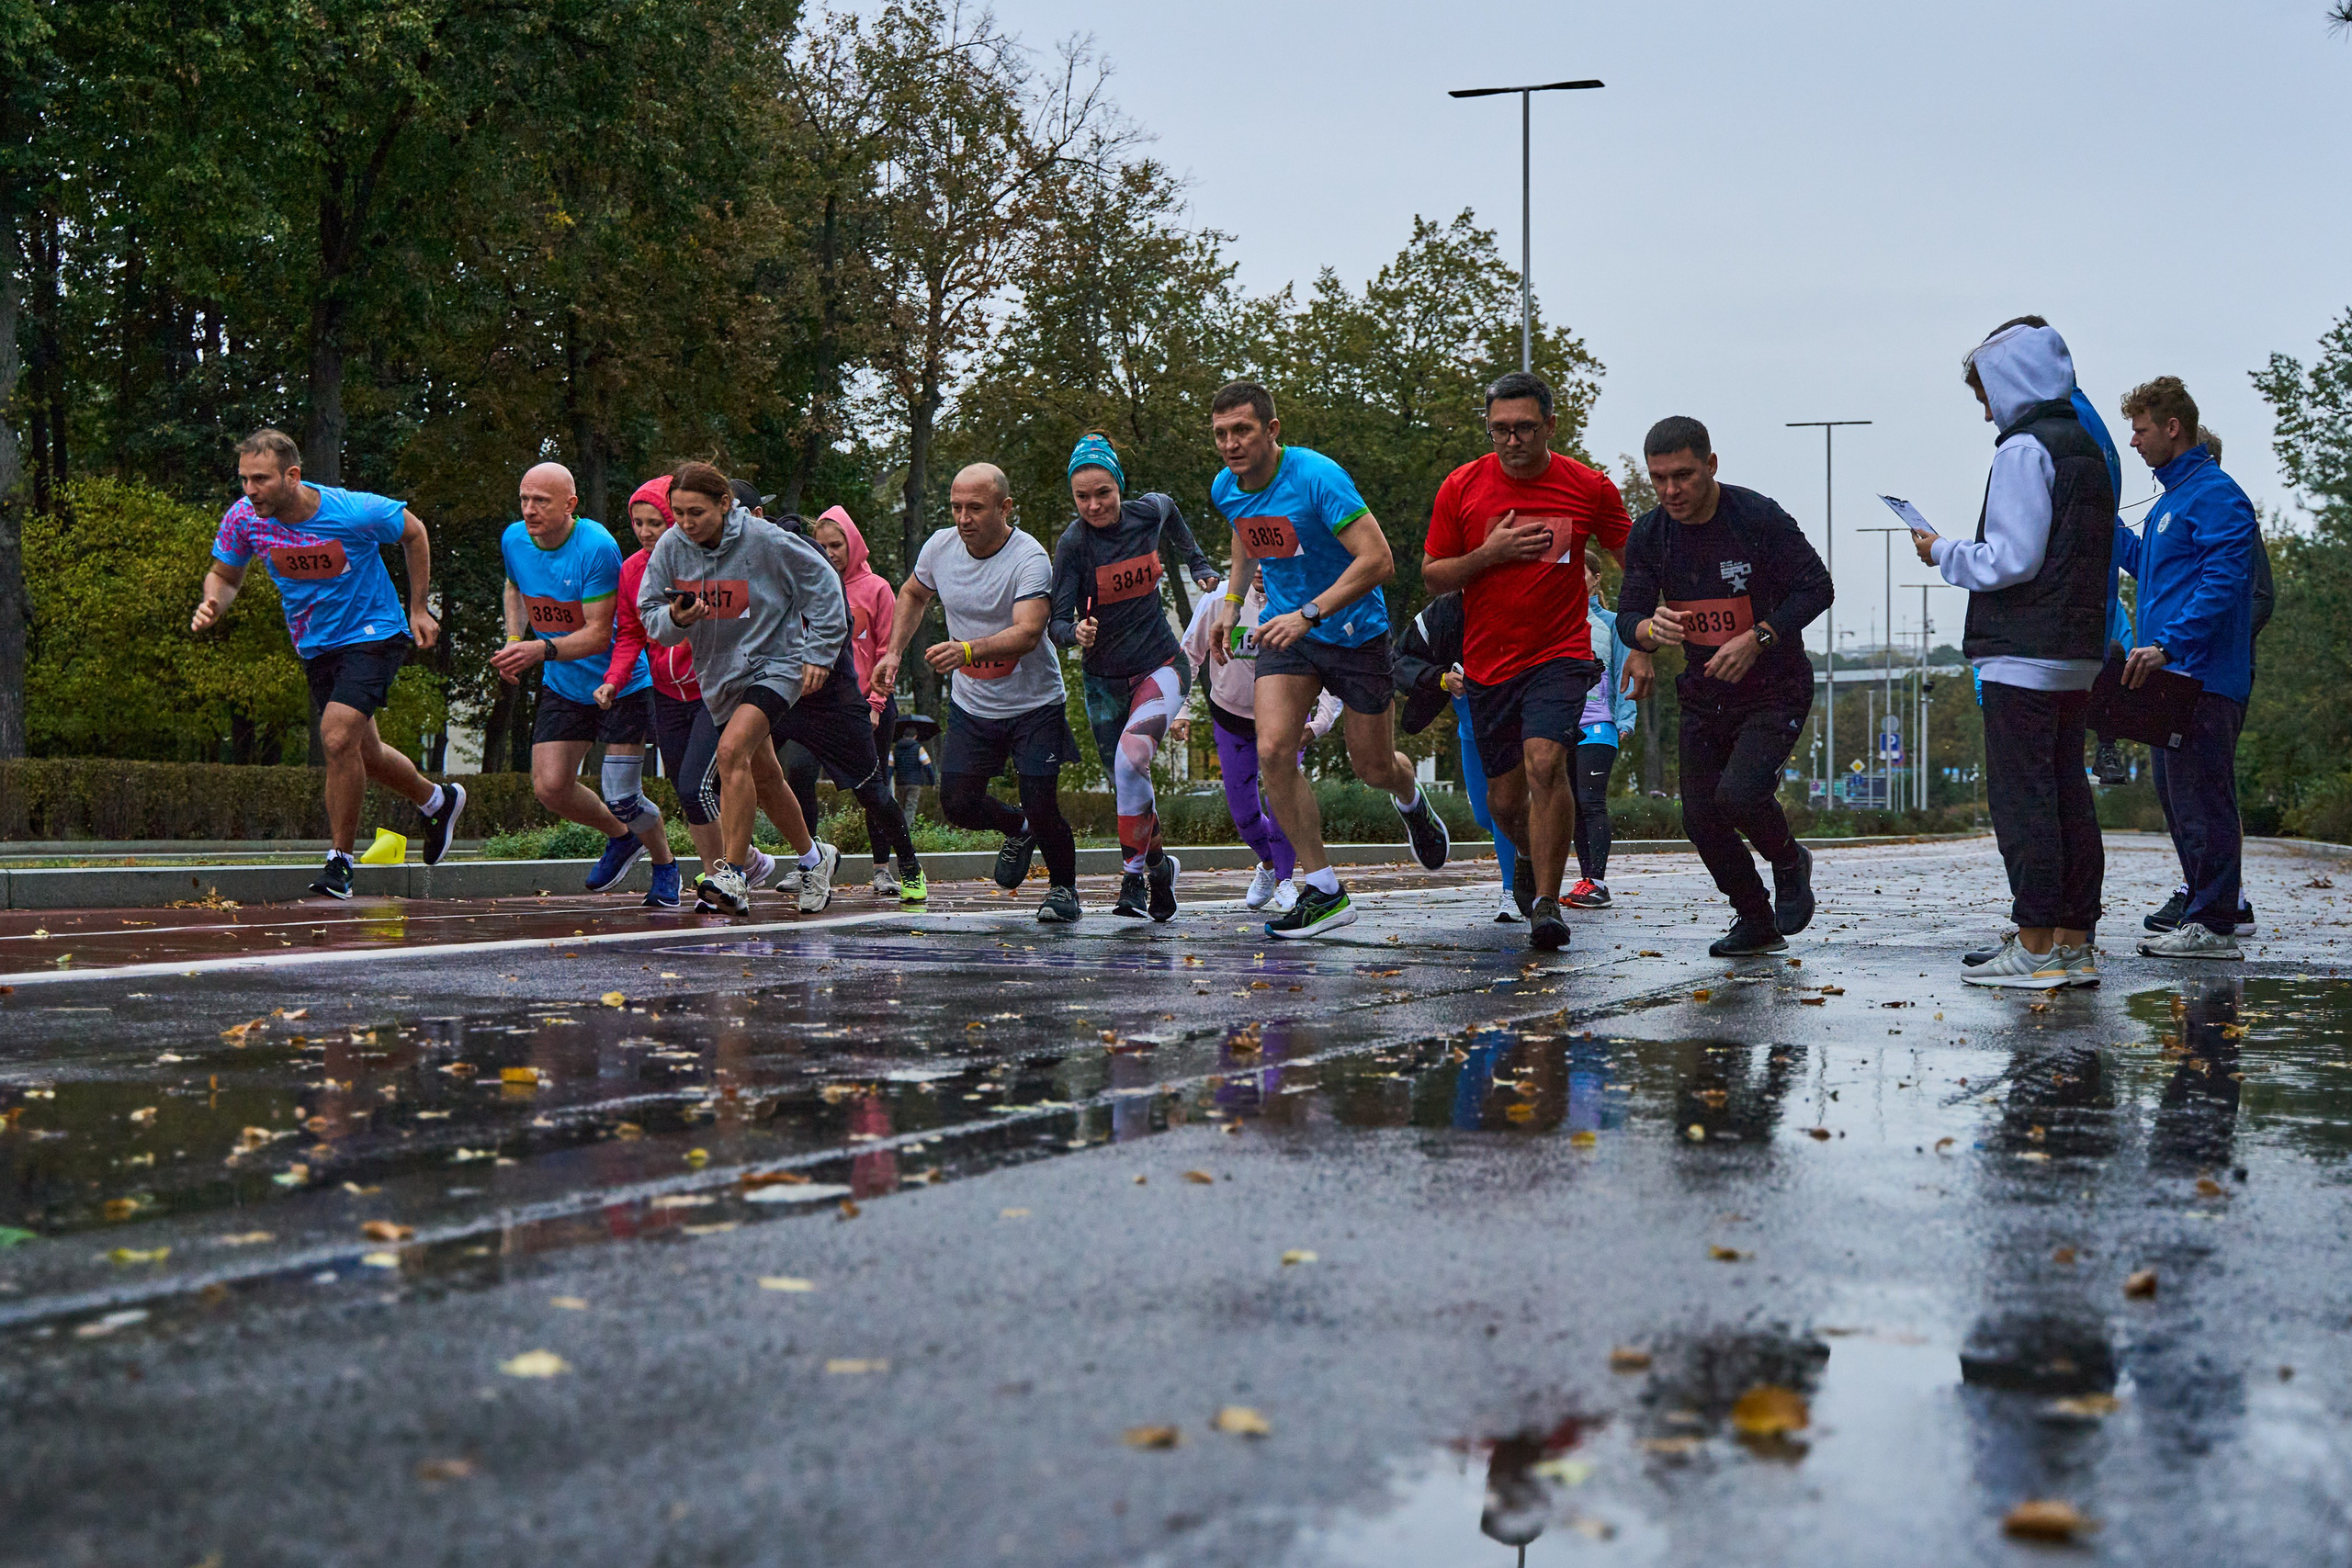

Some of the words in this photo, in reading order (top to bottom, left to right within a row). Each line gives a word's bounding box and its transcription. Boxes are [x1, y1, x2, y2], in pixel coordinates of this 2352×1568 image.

[287, 554, 333, 570] 3873
[1113, 566, 1152, 592] 3841
[532, 606, 573, 623] 3838
